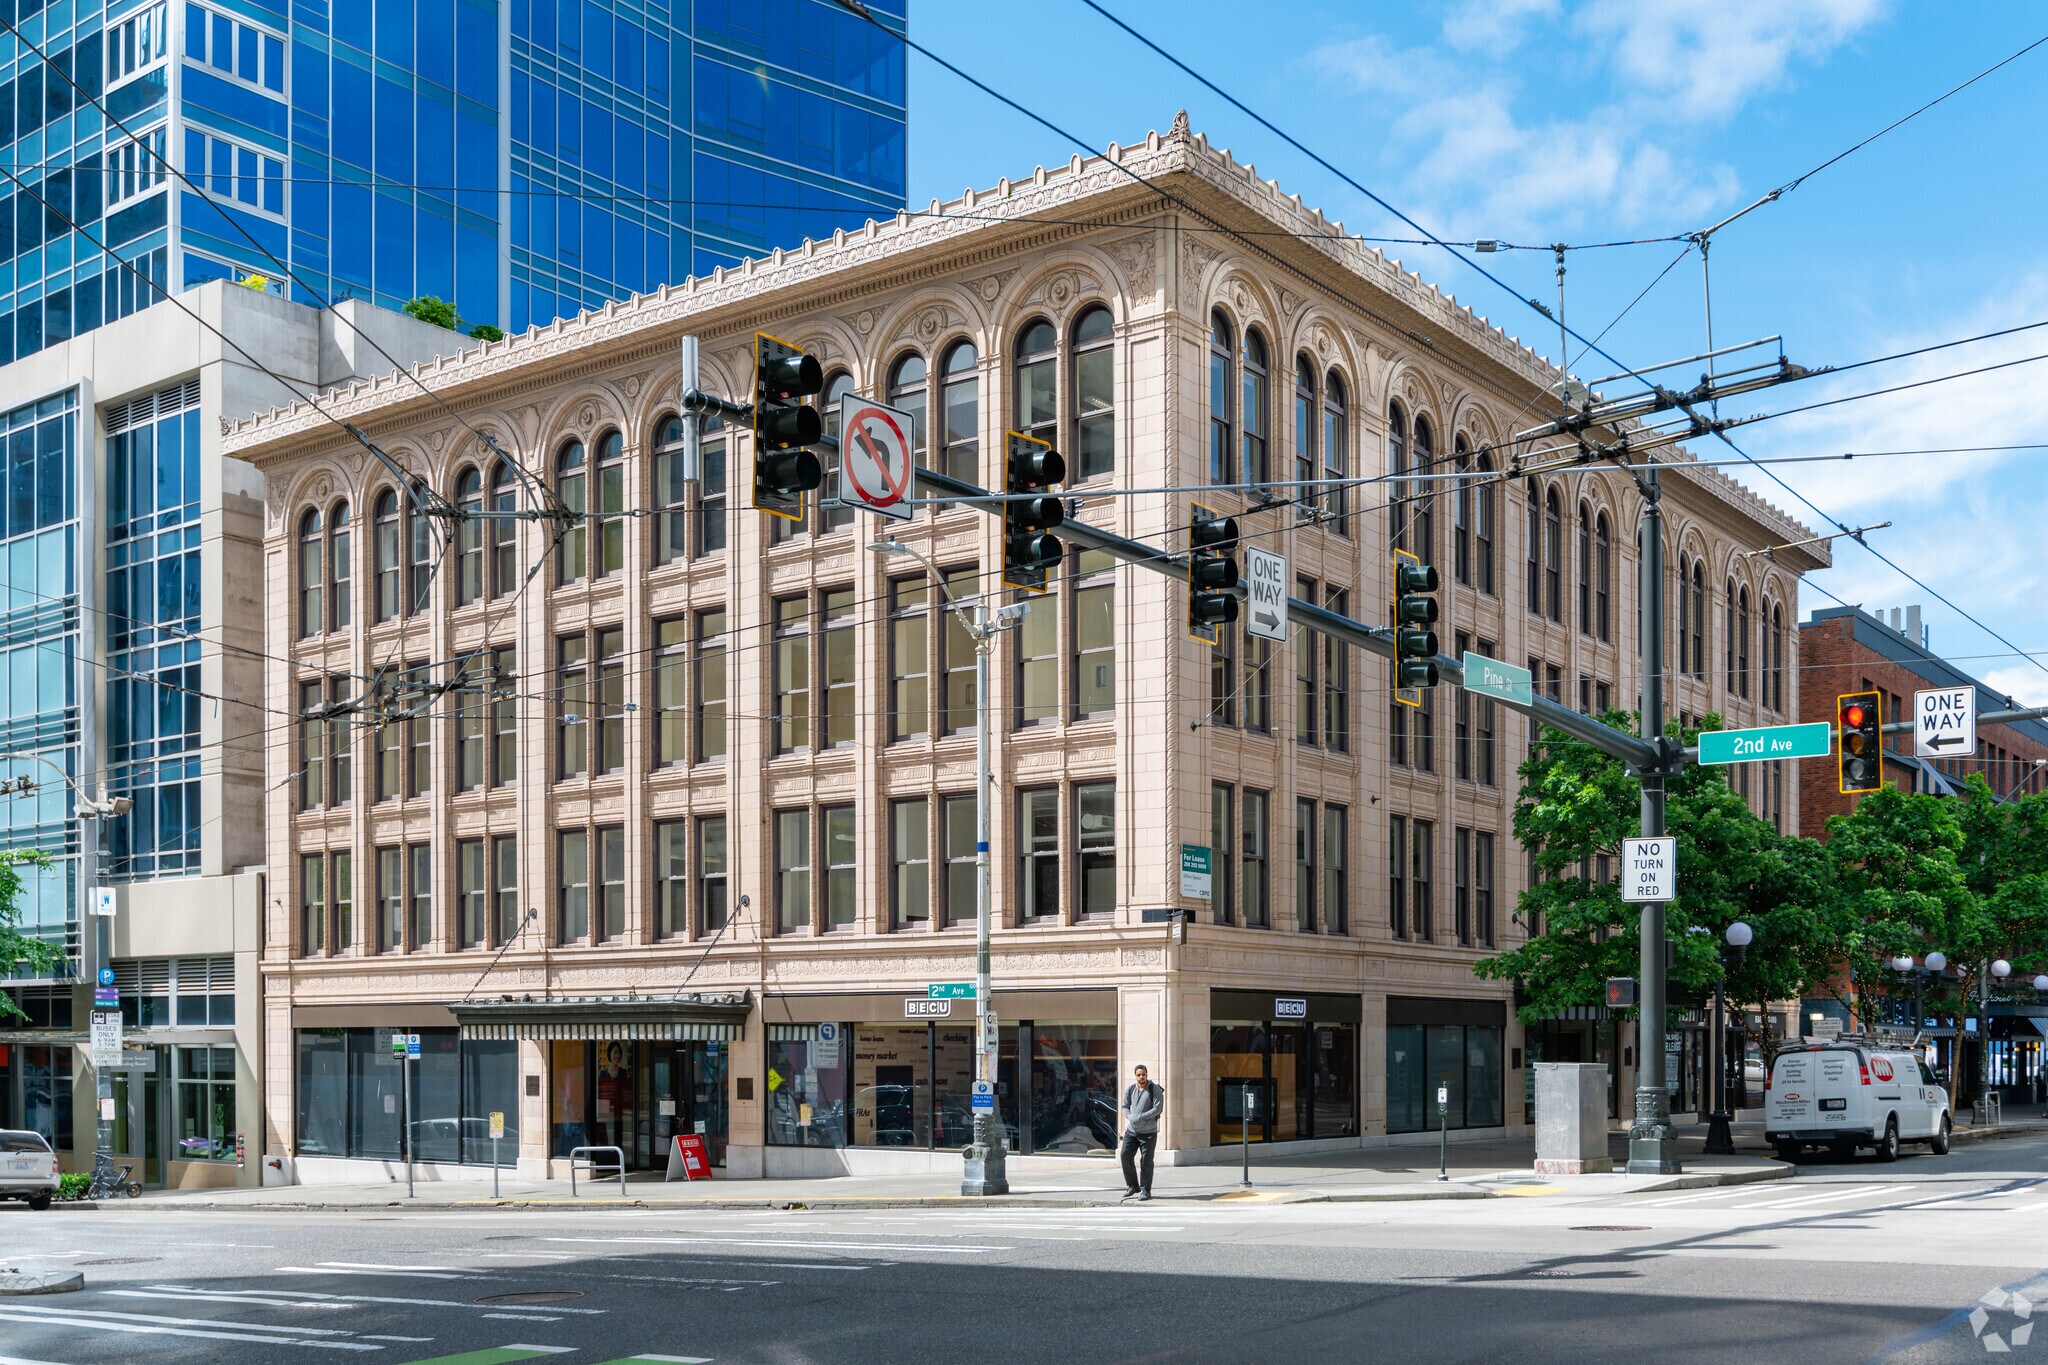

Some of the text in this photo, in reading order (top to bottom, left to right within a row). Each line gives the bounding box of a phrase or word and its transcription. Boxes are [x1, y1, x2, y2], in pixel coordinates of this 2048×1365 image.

[1254, 556, 1281, 583] ONE
[1253, 580, 1282, 606] WAY
[1484, 666, 1504, 690] Pine
[1924, 693, 1965, 712] ONE
[1923, 712, 1966, 731] WAY
[1733, 736, 1793, 755] 2nd Ave
[1638, 843, 1660, 856] NO
[1634, 859, 1663, 869] TURN
[1641, 872, 1656, 882] ON
[1637, 886, 1660, 896] RED
[931, 985, 945, 997] 2nd
[952, 987, 965, 995] Ave
[908, 1002, 948, 1013] BECU
[1278, 1003, 1304, 1014] BECU
[943, 1033, 968, 1044] checking
[856, 1051, 898, 1062] money market
